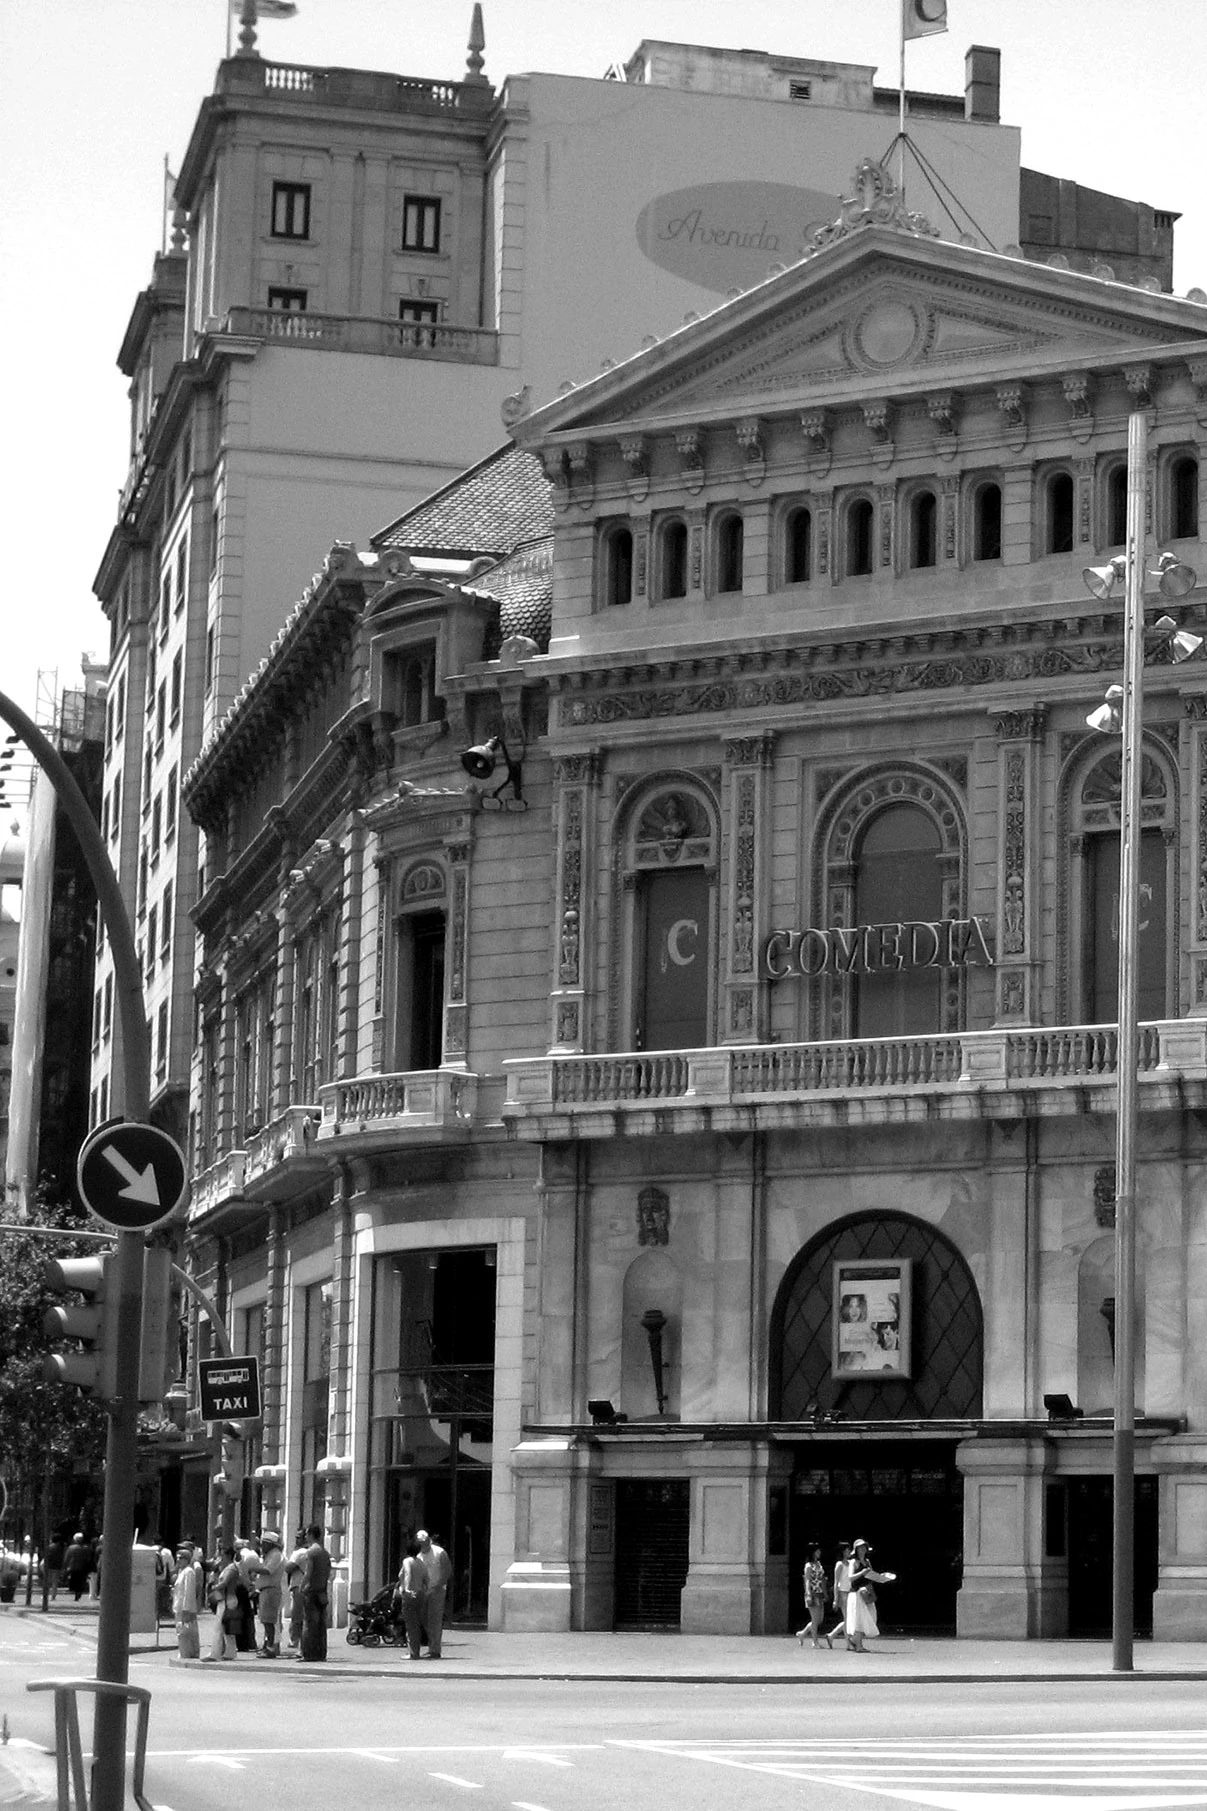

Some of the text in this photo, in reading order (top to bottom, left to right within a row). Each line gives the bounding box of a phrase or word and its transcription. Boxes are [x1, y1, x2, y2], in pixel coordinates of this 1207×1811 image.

[658, 209, 779, 251] Avenida
[765, 916, 994, 980] COMEDIA
[212, 1396, 248, 1410] TAXI
